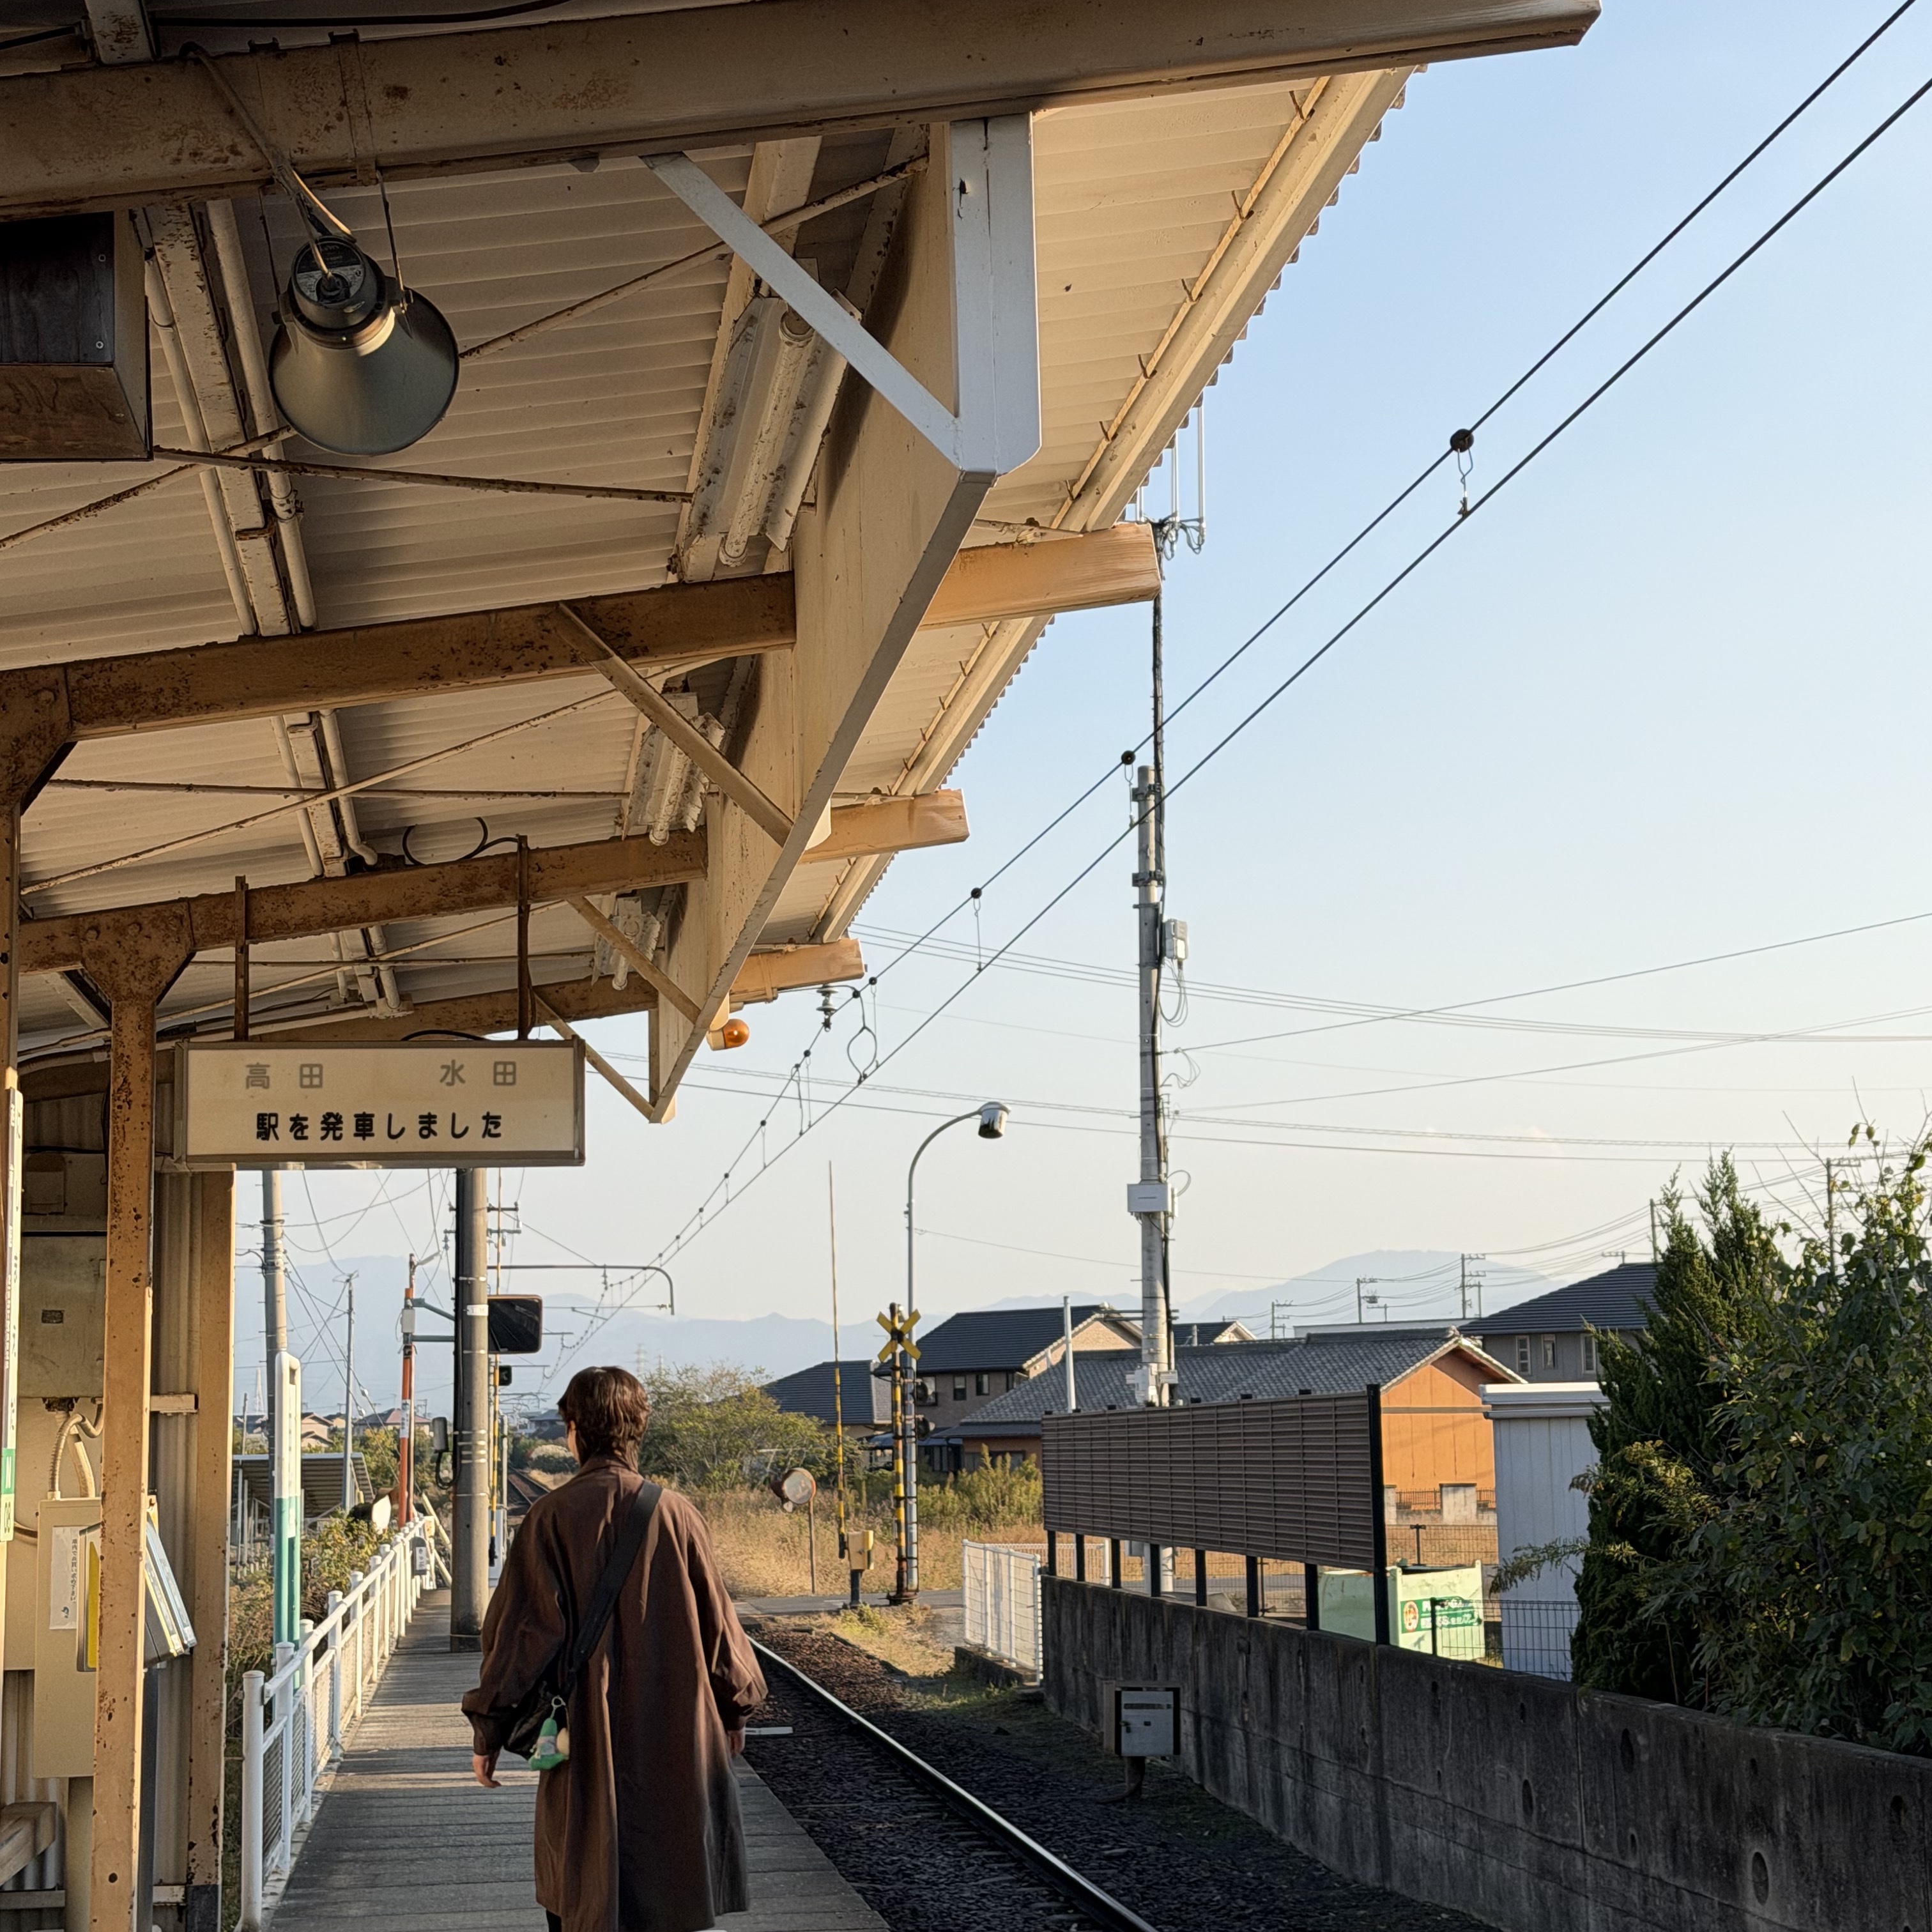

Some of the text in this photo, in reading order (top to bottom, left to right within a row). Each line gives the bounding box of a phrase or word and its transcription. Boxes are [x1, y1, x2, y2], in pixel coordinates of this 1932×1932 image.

[245, 1062, 324, 1089] 高田
[440, 1059, 517, 1086] 水田
[256, 1111, 502, 1141] 駅を発車しました
